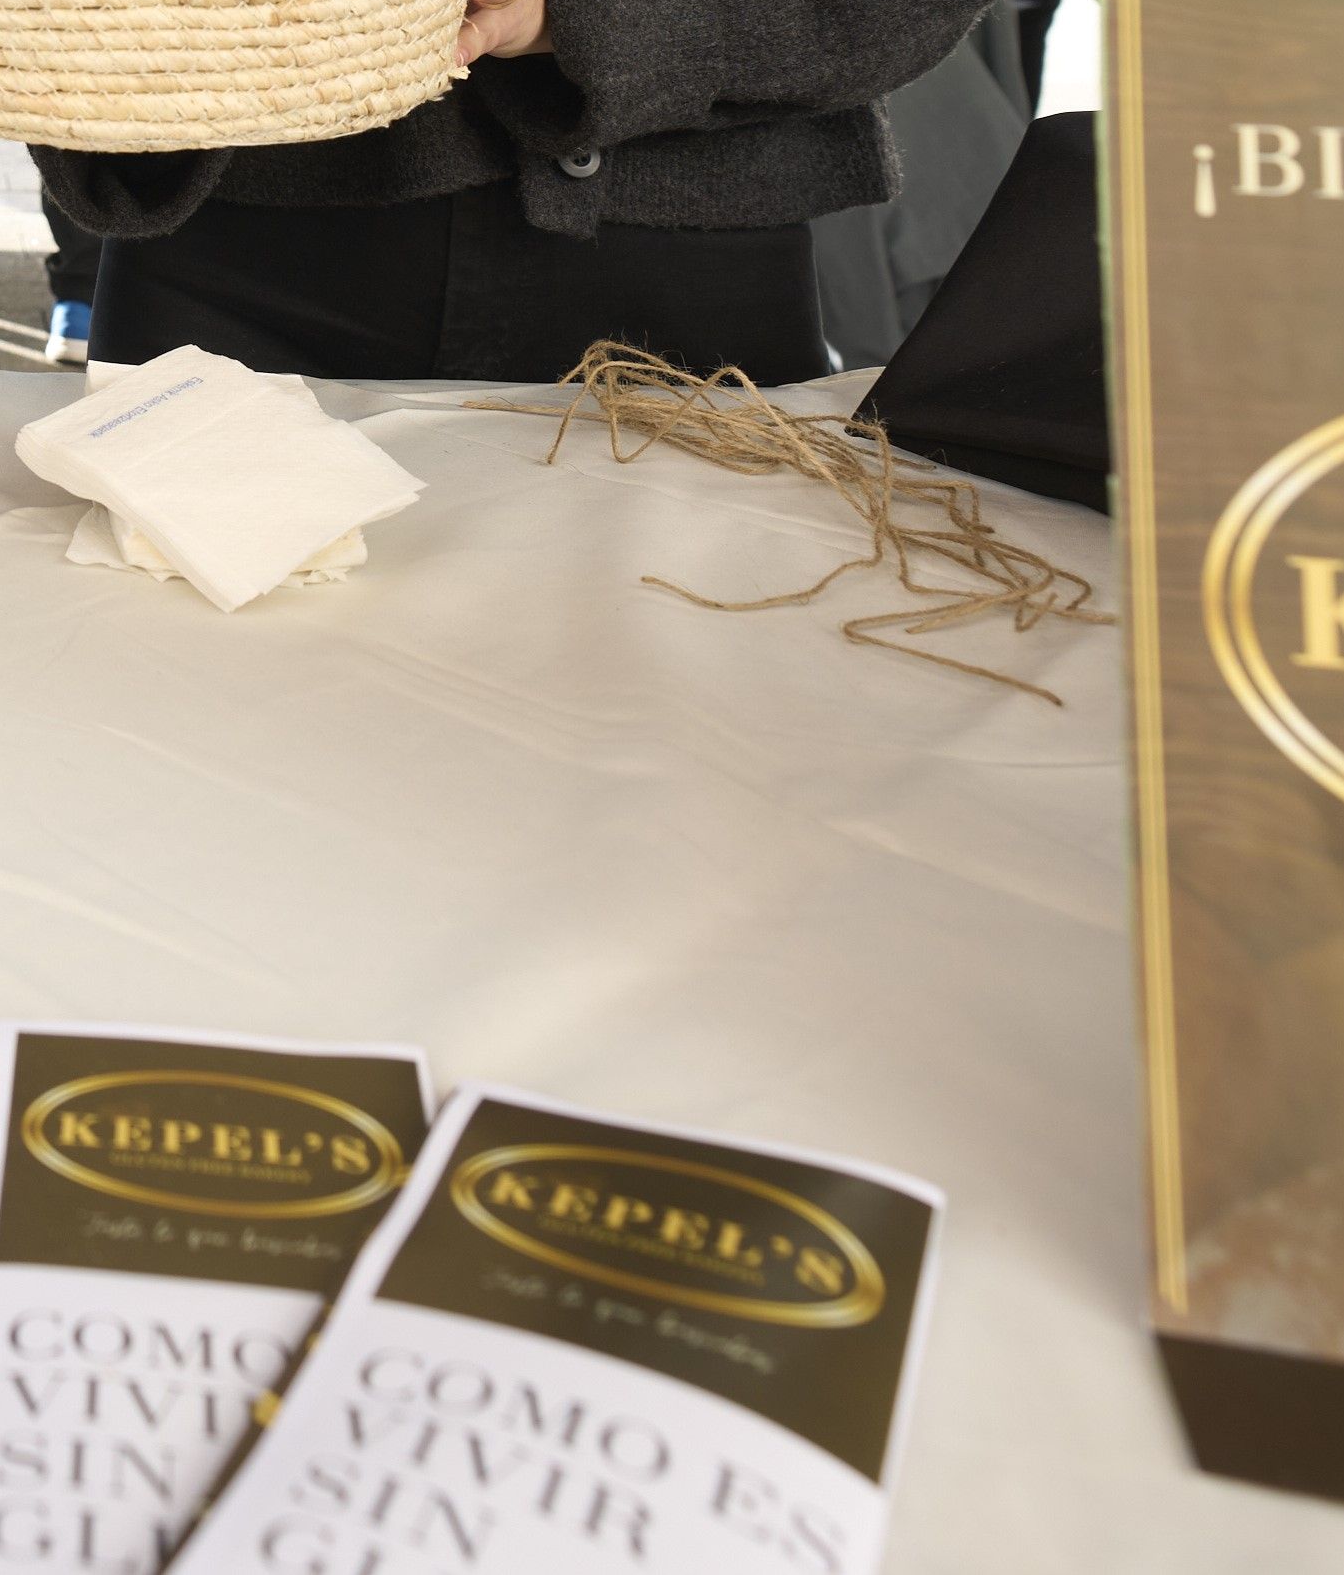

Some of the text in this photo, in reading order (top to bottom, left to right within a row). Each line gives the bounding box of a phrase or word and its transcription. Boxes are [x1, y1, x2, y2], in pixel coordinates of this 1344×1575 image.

[56, 1109, 371, 1175] KEPEL'S
[489, 1170, 846, 1296] KEPEL'S
[7, 1305, 293, 1385] COMO
[5, 1369, 267, 1439] VIVI
[358, 1343, 673, 1485] COMO
[287, 1449, 499, 1545] SIN
[341, 1397, 656, 1563] VIVIR
